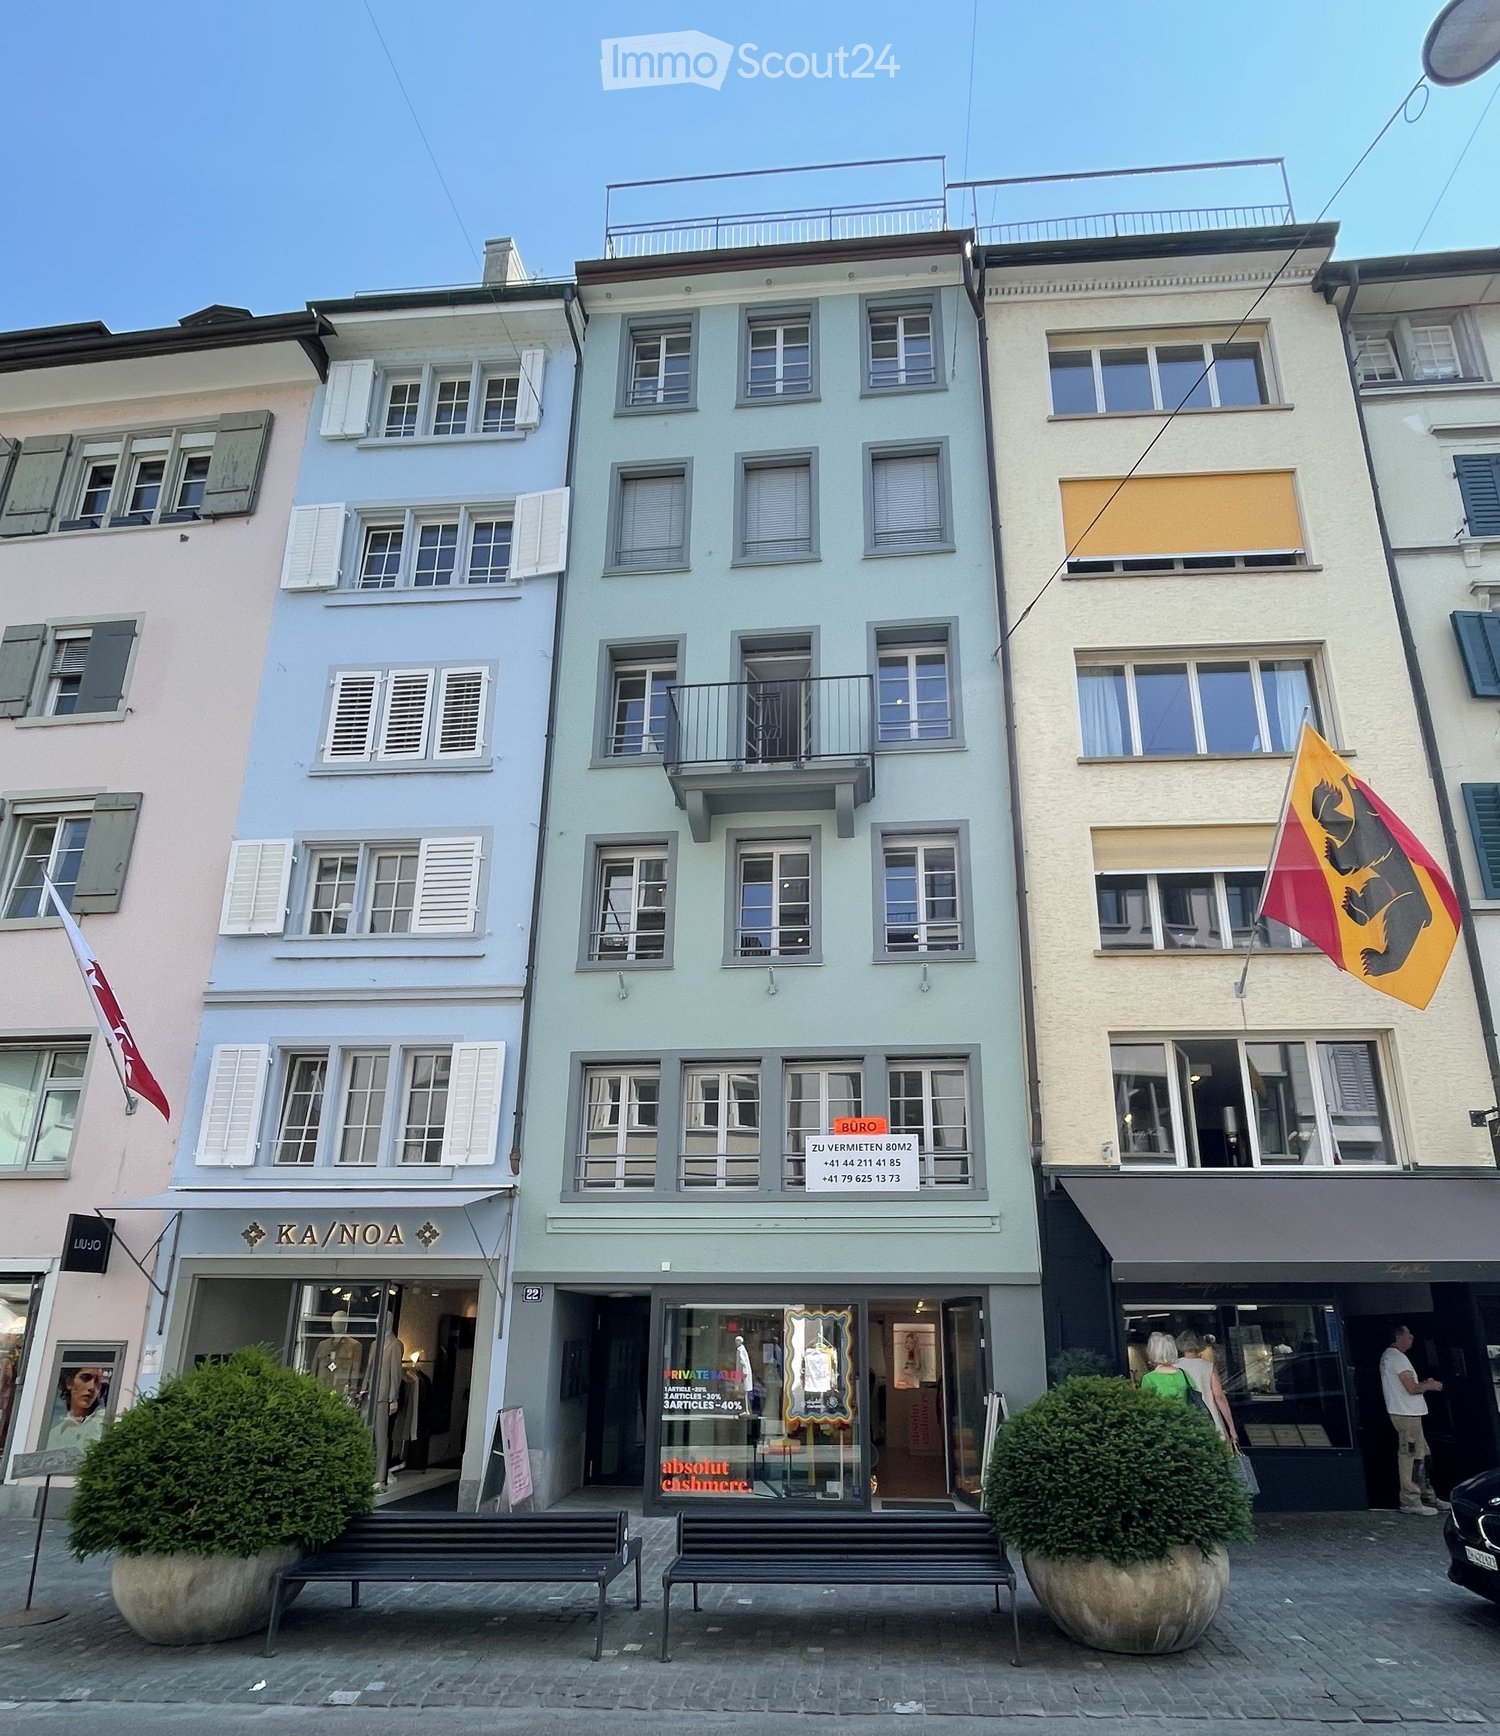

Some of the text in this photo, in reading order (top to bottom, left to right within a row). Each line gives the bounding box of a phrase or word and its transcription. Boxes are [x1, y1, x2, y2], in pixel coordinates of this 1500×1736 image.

[842, 1120, 877, 1132] BÜRO
[812, 1142, 912, 1152] ZU VERMIETEN 80M2
[843, 1159, 854, 1167] 44
[889, 1158, 901, 1166] 85
[822, 1175, 837, 1183] +41
[855, 1174, 873, 1182] 625
[876, 1174, 886, 1182] 13
[889, 1174, 900, 1182] 73
[275, 1221, 403, 1247] KA/NOA
[526, 1288, 539, 1300] 22
[664, 1369, 709, 1379] PRIVATE
[716, 1401, 742, 1410] -40%
[662, 1456, 729, 1475] absolut
